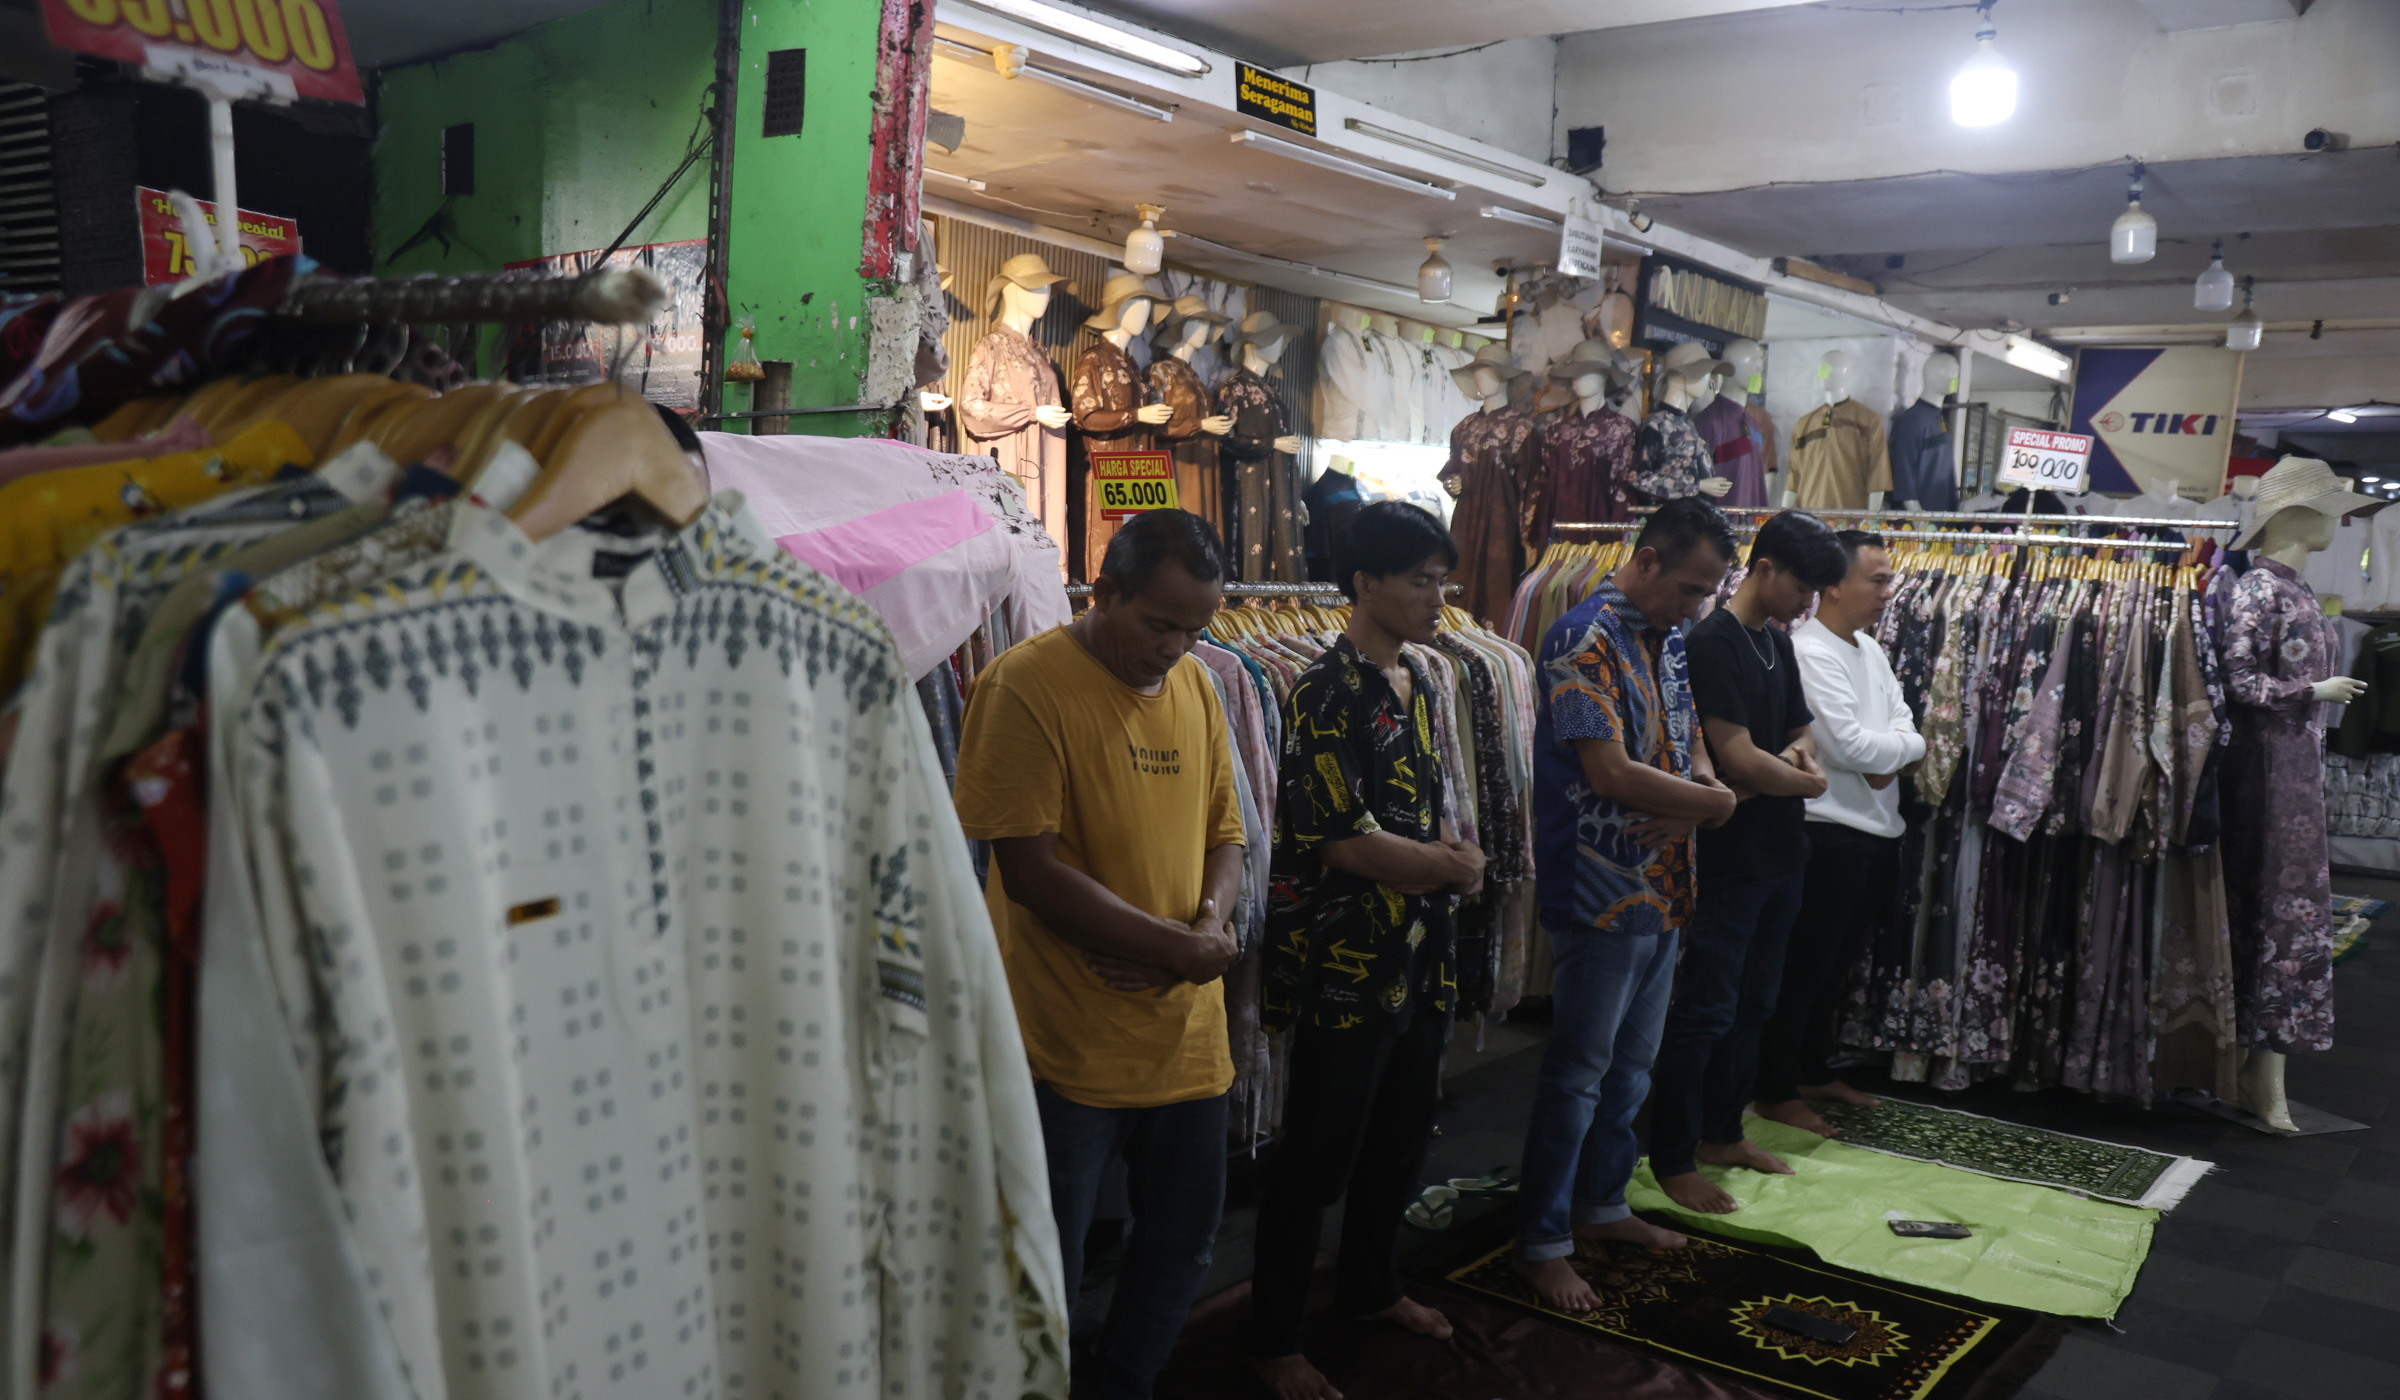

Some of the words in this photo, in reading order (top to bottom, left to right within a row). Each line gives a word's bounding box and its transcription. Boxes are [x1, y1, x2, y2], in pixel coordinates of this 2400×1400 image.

[1244, 66, 1310, 104] Menerima
[1241, 83, 1314, 123] Seragaman
[2130, 412, 2218, 435] TIKI
[2012, 431, 2051, 448] SPECIAL
[2052, 435, 2087, 452] PROMO
[1100, 460, 1128, 476] HARGA
[1130, 459, 1166, 476] SPECIAL
[1104, 482, 1167, 505] 65.000
